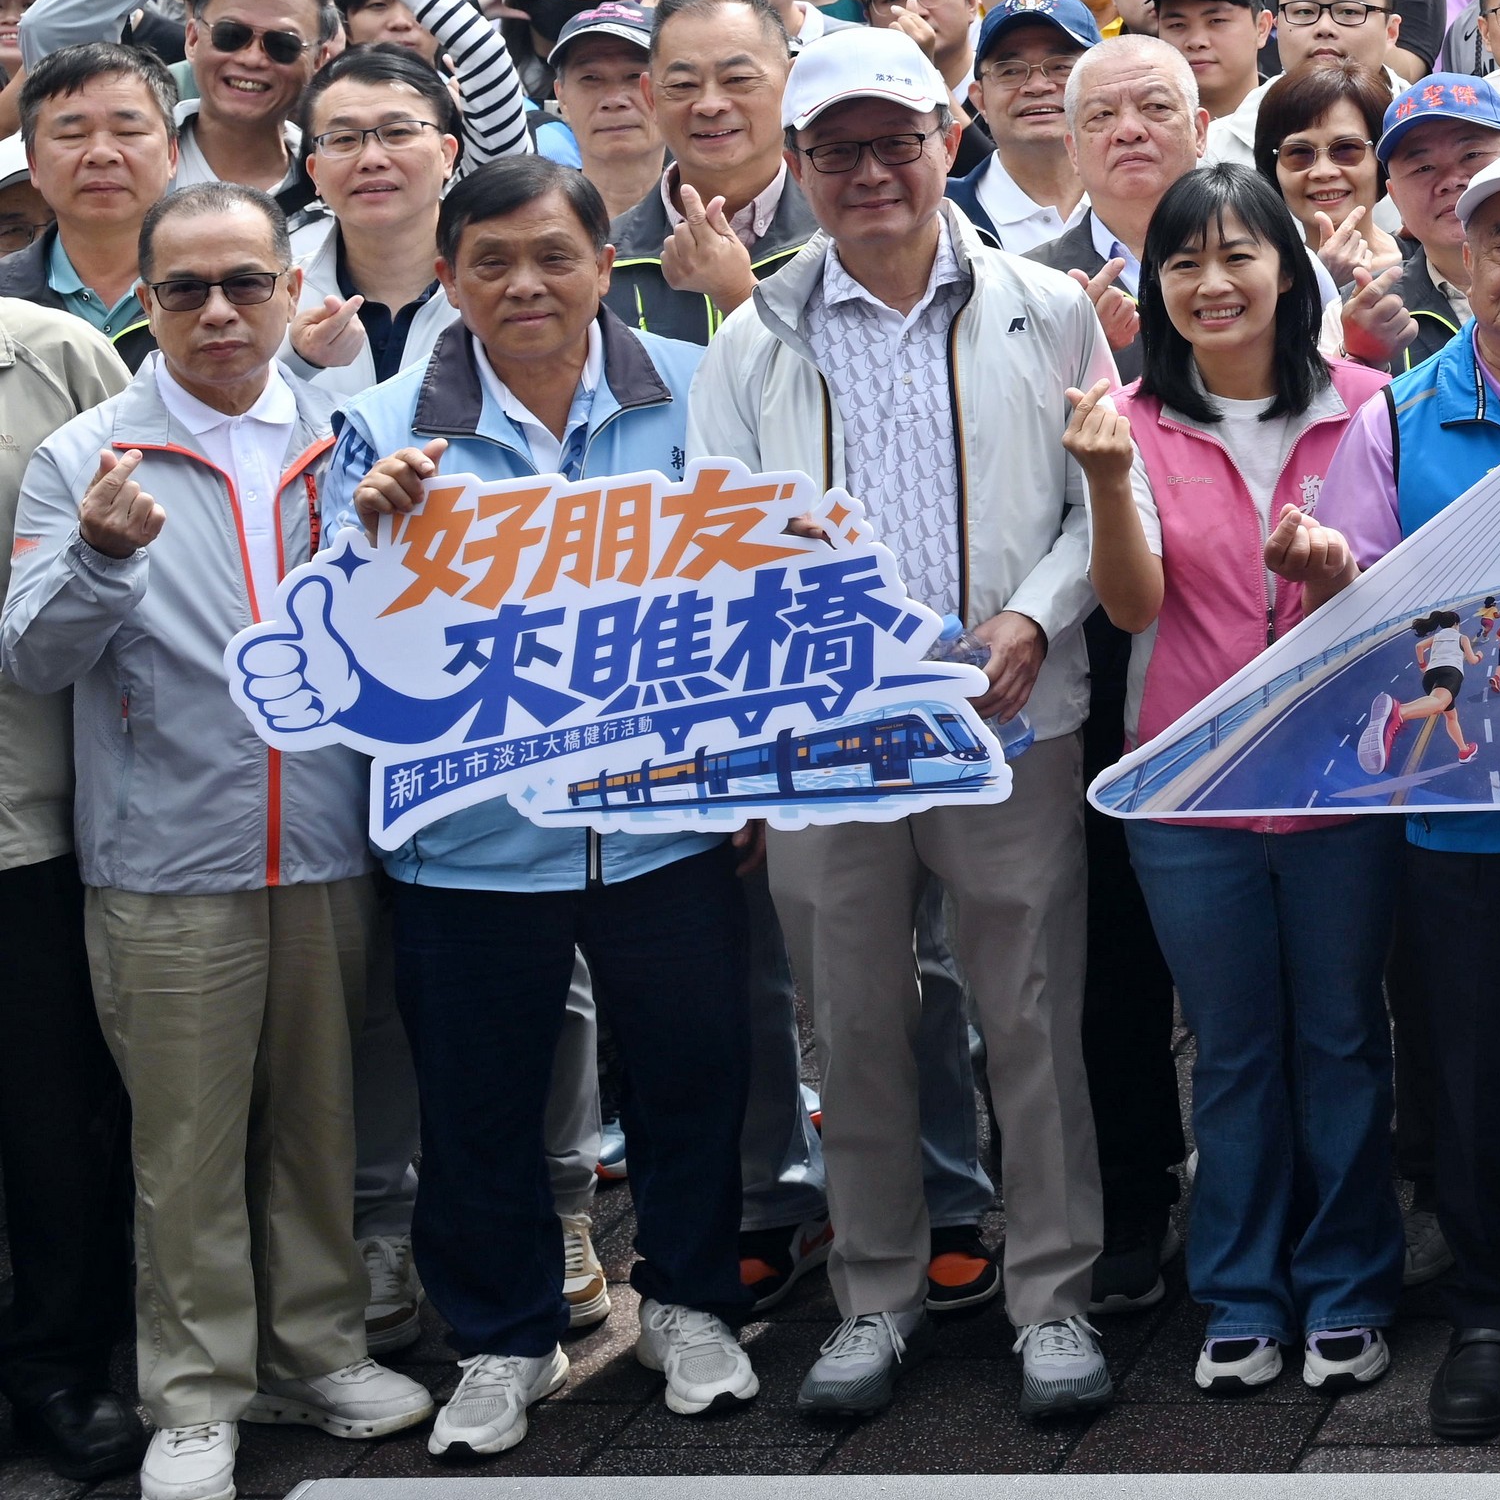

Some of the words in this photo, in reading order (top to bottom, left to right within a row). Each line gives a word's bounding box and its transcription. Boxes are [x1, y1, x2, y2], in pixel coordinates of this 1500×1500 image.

[1395, 84, 1480, 120] 林聖傑
[443, 555, 922, 743] 來瞧橋
[389, 717, 654, 809] 新北市淡江大橋健行活動
